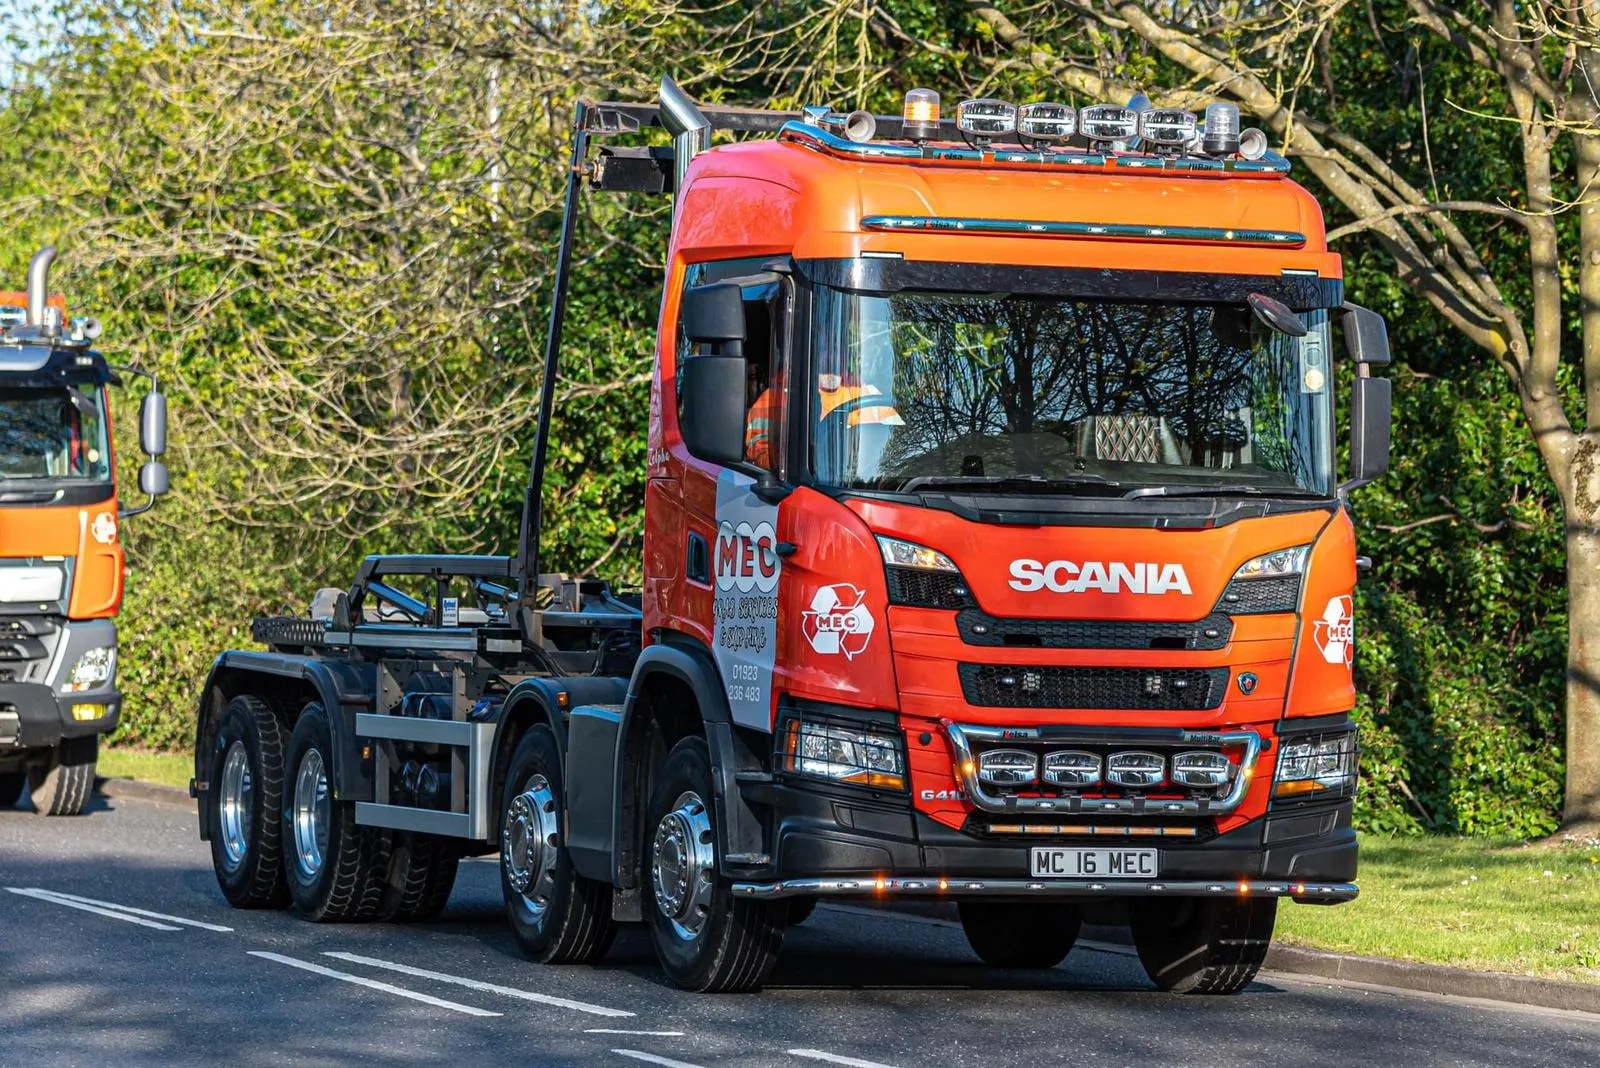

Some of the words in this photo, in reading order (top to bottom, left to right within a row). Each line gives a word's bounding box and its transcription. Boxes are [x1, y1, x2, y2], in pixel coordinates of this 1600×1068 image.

[718, 535, 776, 577] MEC
[1008, 559, 1192, 595] SCANIA
[818, 616, 856, 629] MEC
[1330, 626, 1352, 638] MEC
[732, 664, 758, 681] 01923
[728, 685, 744, 701] 236
[745, 686, 760, 702] 483
[1036, 851, 1065, 874] MC
[1077, 851, 1097, 874] 16
[1109, 851, 1152, 874] MEC
